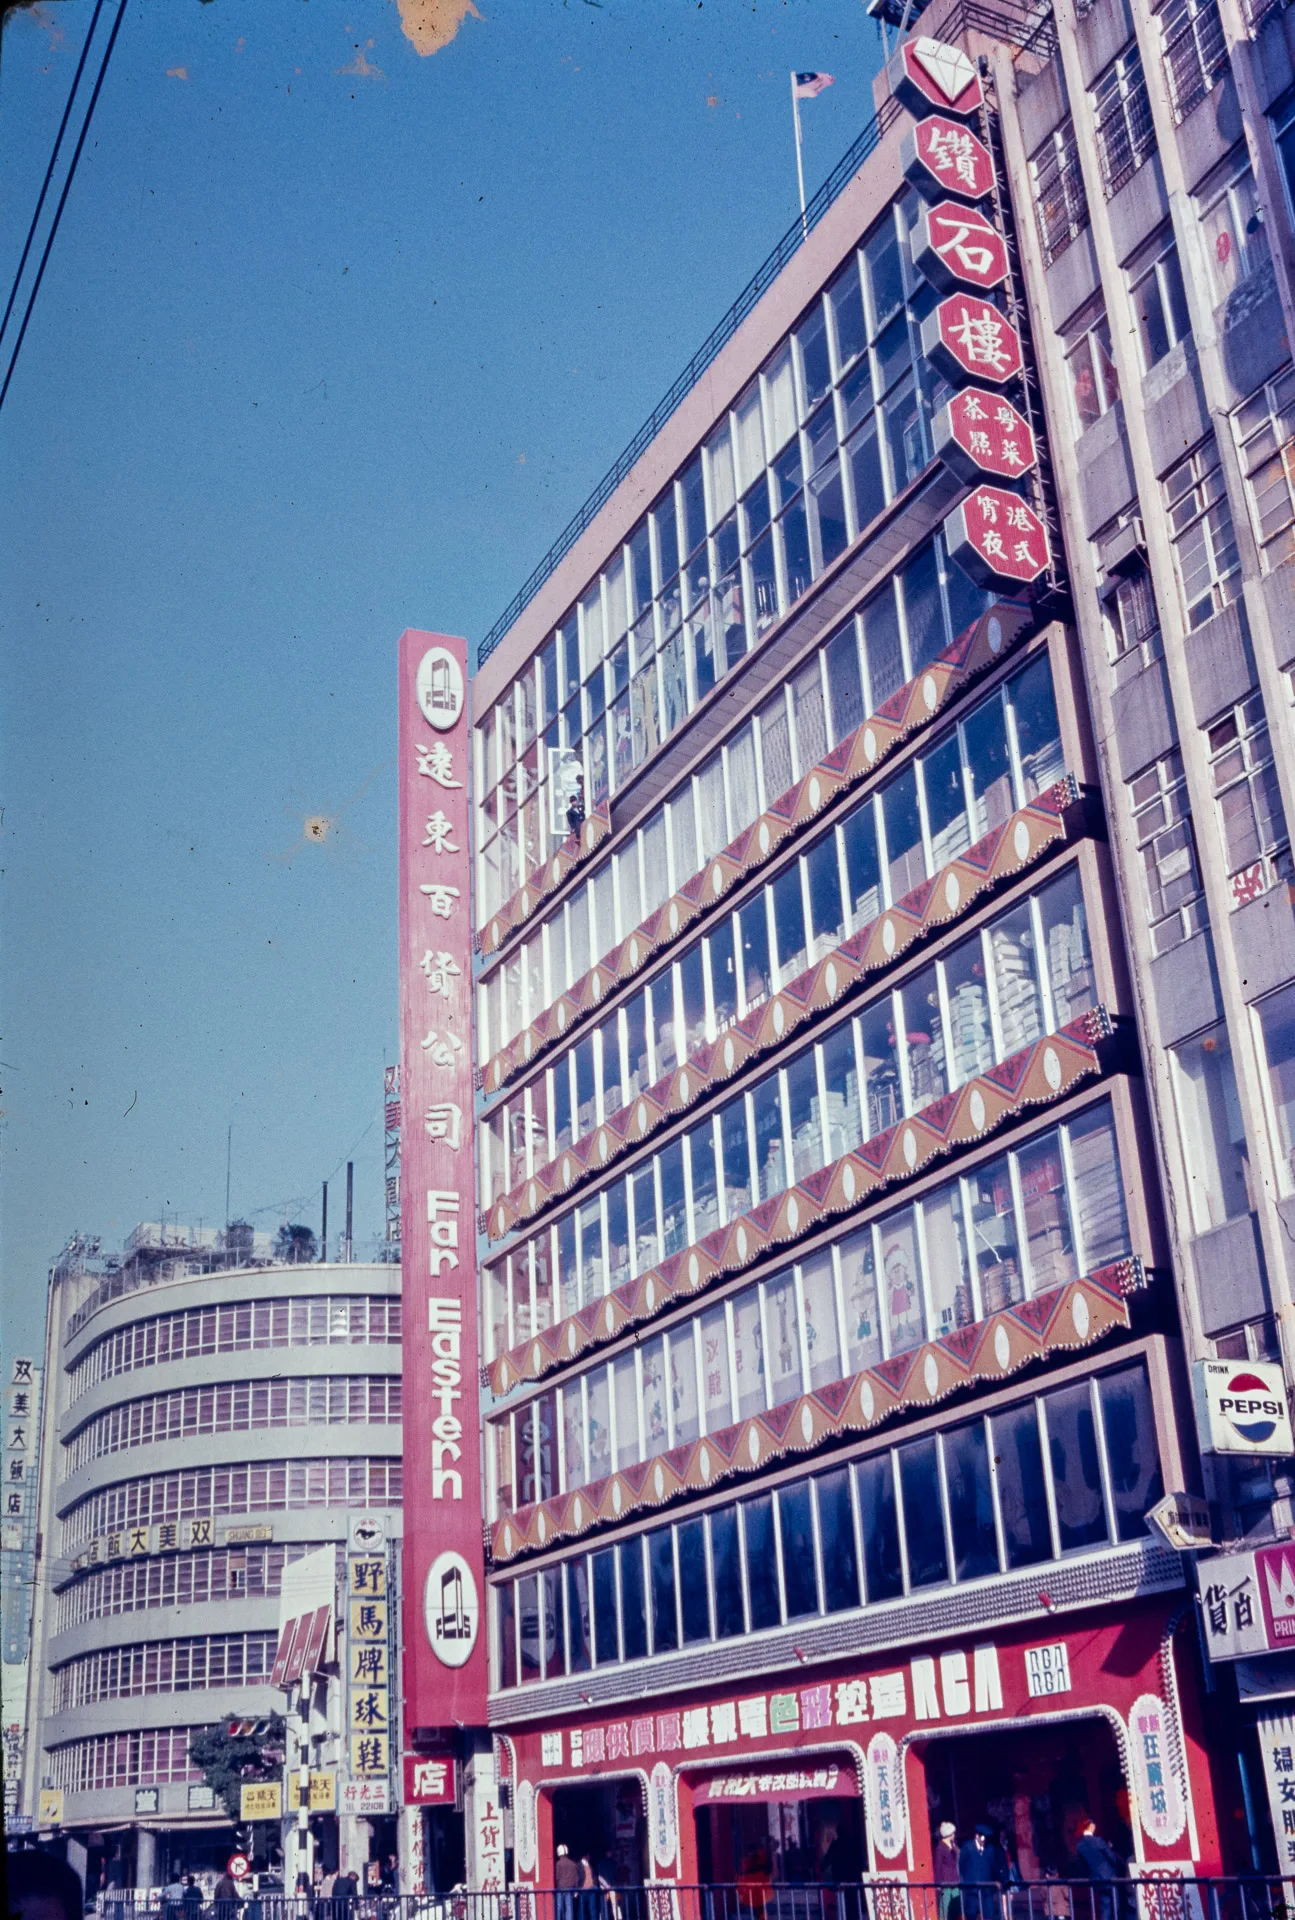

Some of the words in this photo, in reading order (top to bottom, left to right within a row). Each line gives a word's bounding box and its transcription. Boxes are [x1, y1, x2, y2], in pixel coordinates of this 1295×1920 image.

[928, 126, 1011, 373] 鑽石樓
[977, 495, 1009, 561] 宵夜
[1006, 506, 1039, 568] 港式
[415, 740, 463, 1152] 遠東百貨公司
[427, 1190, 459, 1277] Far
[428, 1297, 462, 1500] Eastern
[1207, 1364, 1230, 1375] DRINK
[1219, 1398, 1285, 1417] PEPSI
[354, 1561, 387, 1773] 野馬牌球鞋
[910, 1641, 1004, 1721] RCA
[413, 1760, 447, 1797] 店
